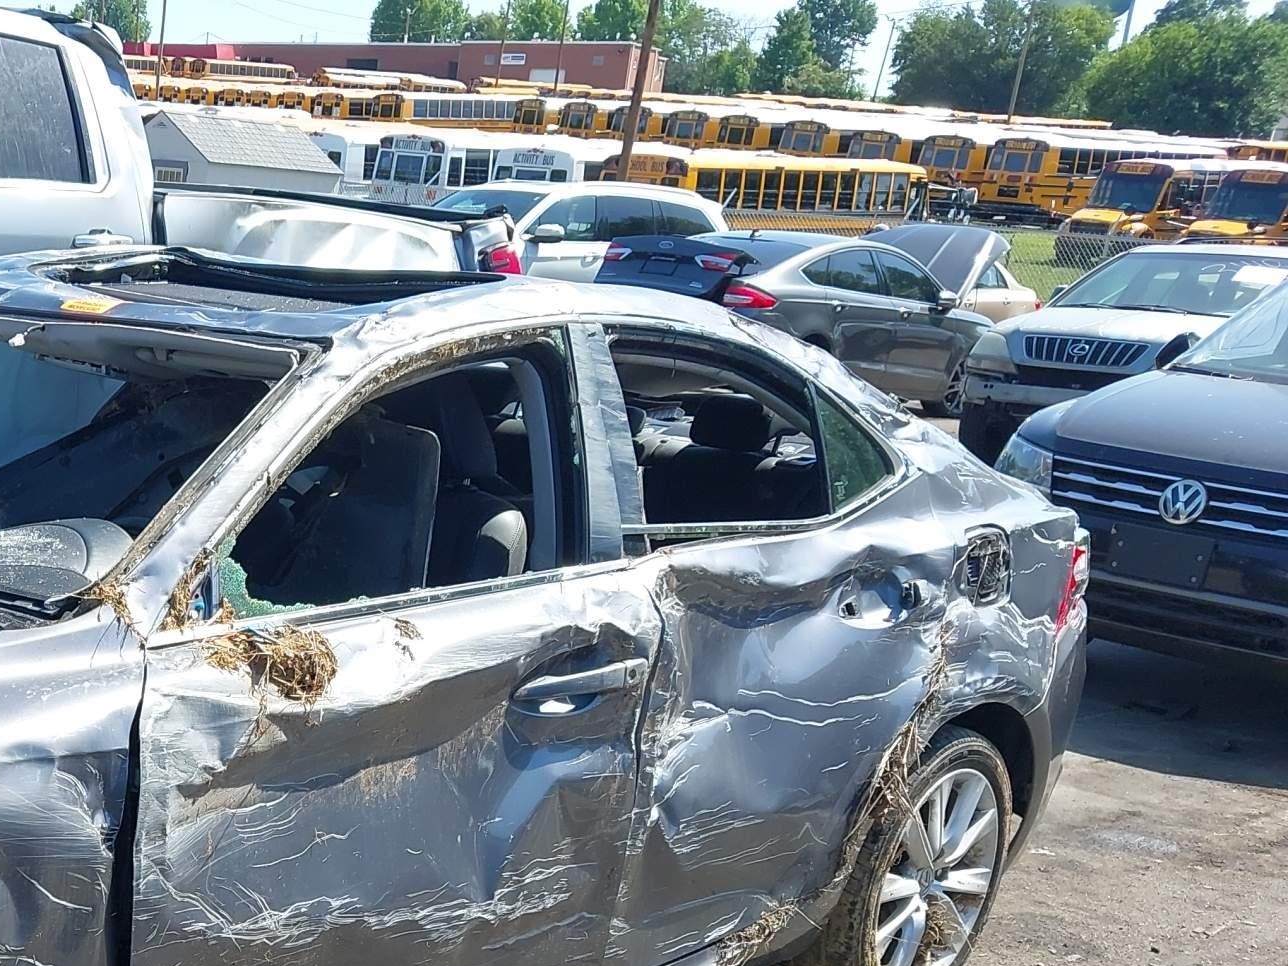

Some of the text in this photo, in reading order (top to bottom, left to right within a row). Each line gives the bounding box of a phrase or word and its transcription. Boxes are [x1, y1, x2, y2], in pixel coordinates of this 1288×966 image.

[394, 139, 419, 151] ACTIVITY
[512, 153, 556, 166] ACTIVITY BUS
